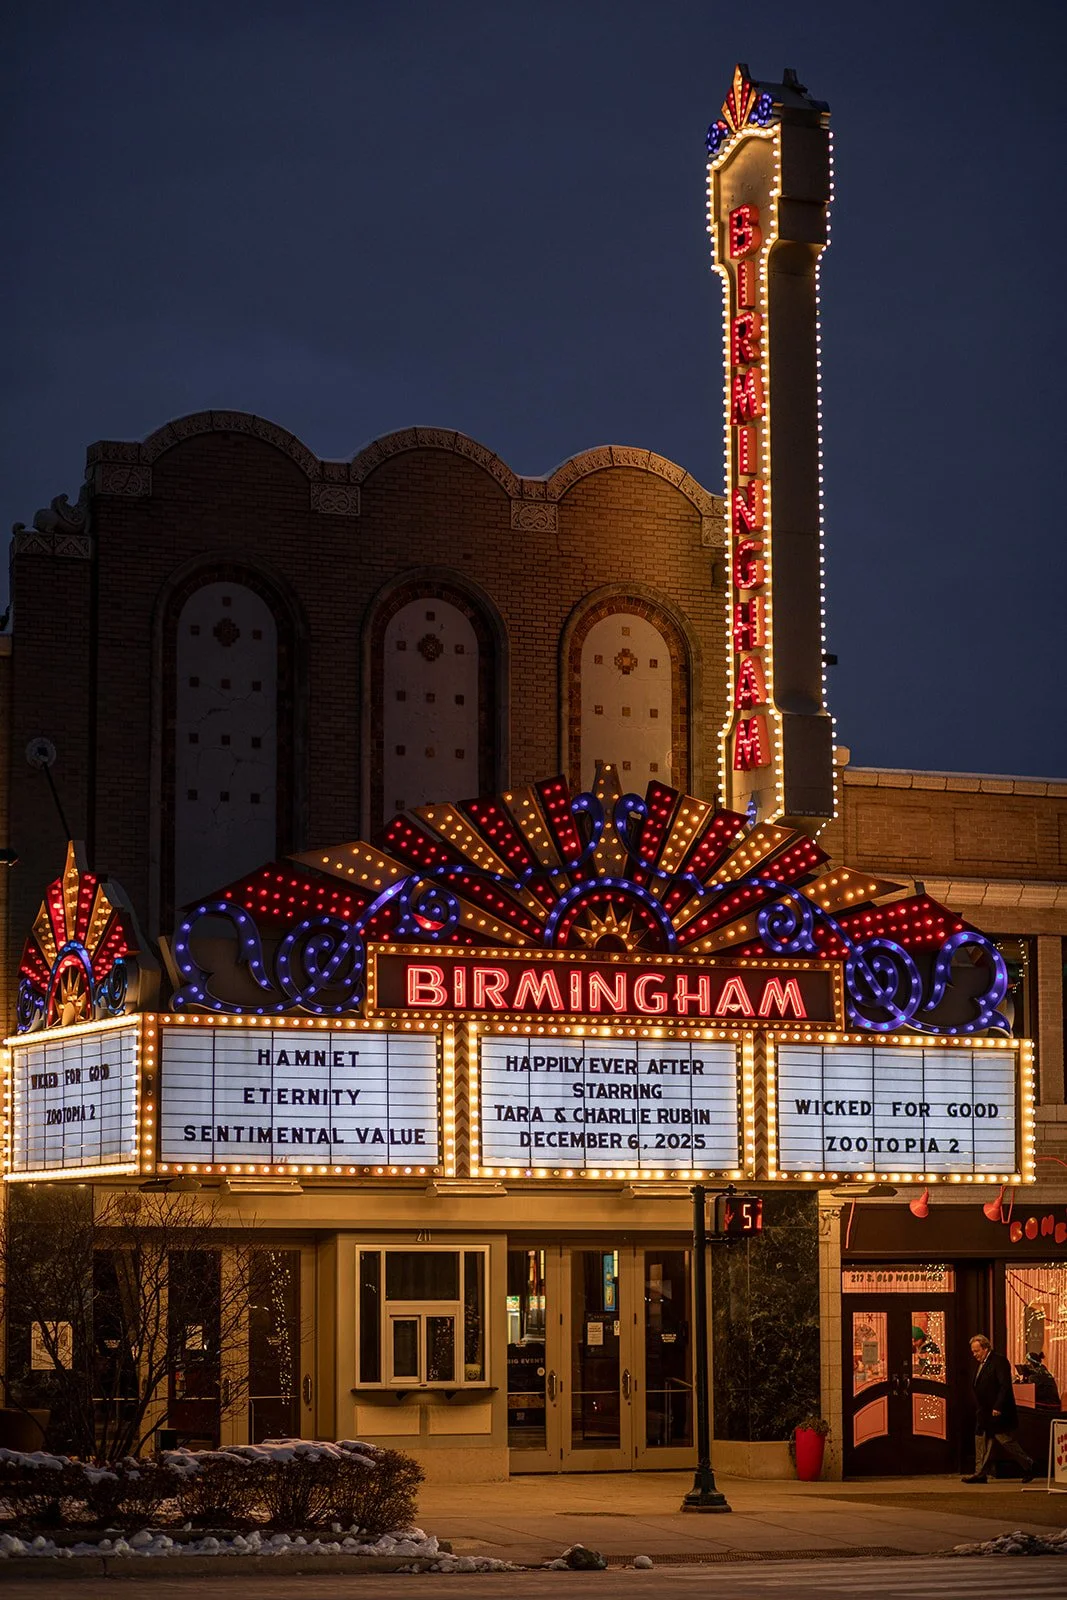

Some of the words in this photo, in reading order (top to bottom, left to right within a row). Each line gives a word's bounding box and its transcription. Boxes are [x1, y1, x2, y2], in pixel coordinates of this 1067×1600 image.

[729, 204, 772, 771] BIRMINGHAM
[406, 964, 808, 1019] BIRMINGHAM
[257, 1049, 360, 1067] HAMNET
[505, 1056, 584, 1073] HAPPILY
[589, 1057, 638, 1075] EVER
[647, 1059, 704, 1075] AFTER
[30, 1072, 59, 1090] WICKED
[65, 1068, 81, 1085] FOR
[89, 1063, 110, 1082] GOOD
[243, 1087, 361, 1105] ETERNITY
[572, 1082, 662, 1099] STARRING
[46, 1105, 86, 1125] ZOOTOPIA
[90, 1104, 96, 1120] 2
[494, 1104, 544, 1122] TARA
[554, 1106, 567, 1123] &
[572, 1107, 651, 1124] CHARLIE
[657, 1108, 711, 1125] RUBIN
[795, 1099, 872, 1116] WICKED
[892, 1102, 931, 1117] FOR
[947, 1103, 999, 1118] GOOD
[183, 1124, 344, 1144] SENTIMENTAL
[355, 1128, 425, 1145] VALUE
[519, 1131, 622, 1149] DECEMBER
[655, 1133, 706, 1150] 2025
[825, 1136, 939, 1153] ZOOTOPIA
[949, 1138, 960, 1153] 2
[742, 1203, 752, 1229] 5
[416, 1229, 431, 1242] 211
[851, 1273, 864, 1283] 217
[866, 1273, 875, 1283] S.
[876, 1273, 893, 1283] OLD
[895, 1272, 943, 1282] WOODWARD
